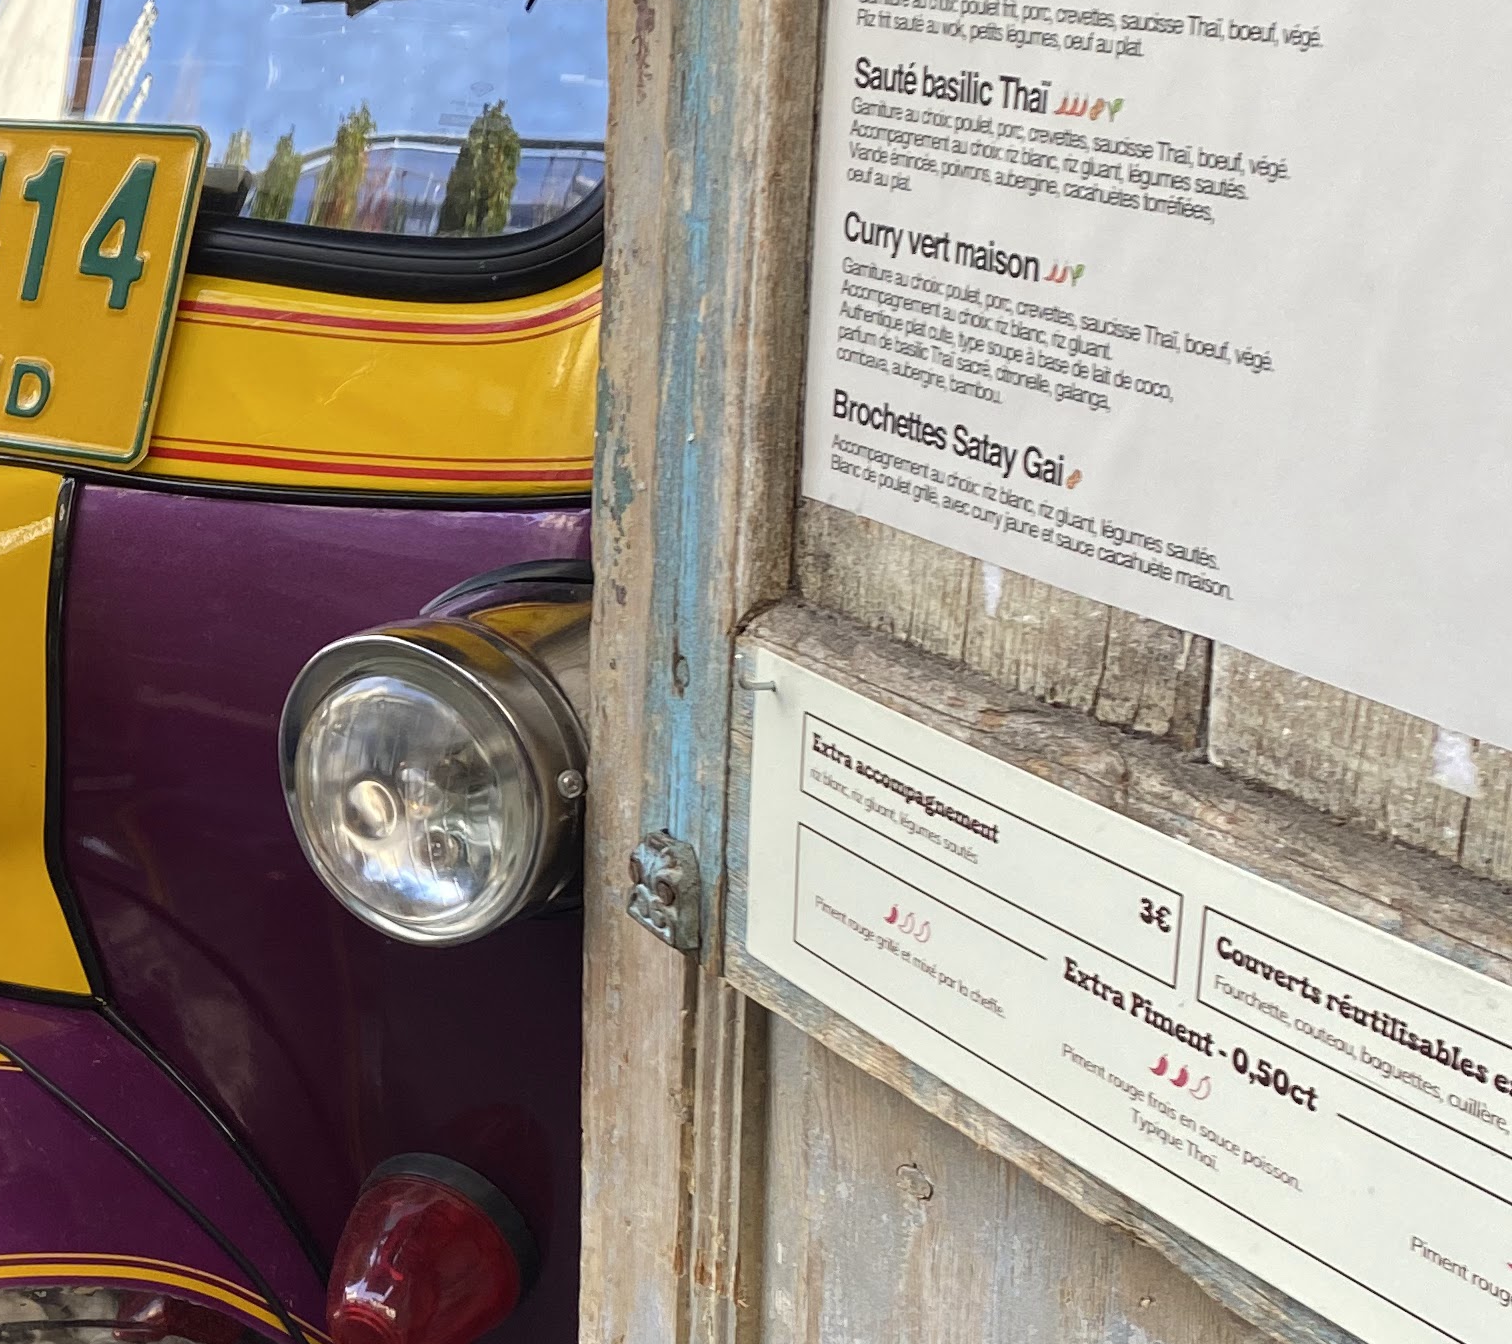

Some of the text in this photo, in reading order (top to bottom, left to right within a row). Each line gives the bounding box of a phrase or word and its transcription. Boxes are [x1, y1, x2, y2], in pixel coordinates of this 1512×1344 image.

[853, 56, 1052, 114] Sauté basilic Thaï
[843, 210, 1040, 282] Curry vert maison
[832, 388, 1064, 486] Brochettes Satay Gai
[811, 731, 1000, 844] Extra accompagnement
[1138, 897, 1172, 933] 3€
[1062, 955, 1126, 1010] Extra
[1129, 991, 1214, 1056] Piment
[1231, 1047, 1318, 1111] 0,50ct
[1215, 935, 1489, 1084] Couverts réutilisables
[1409, 1235, 1512, 1307] Piment roug
